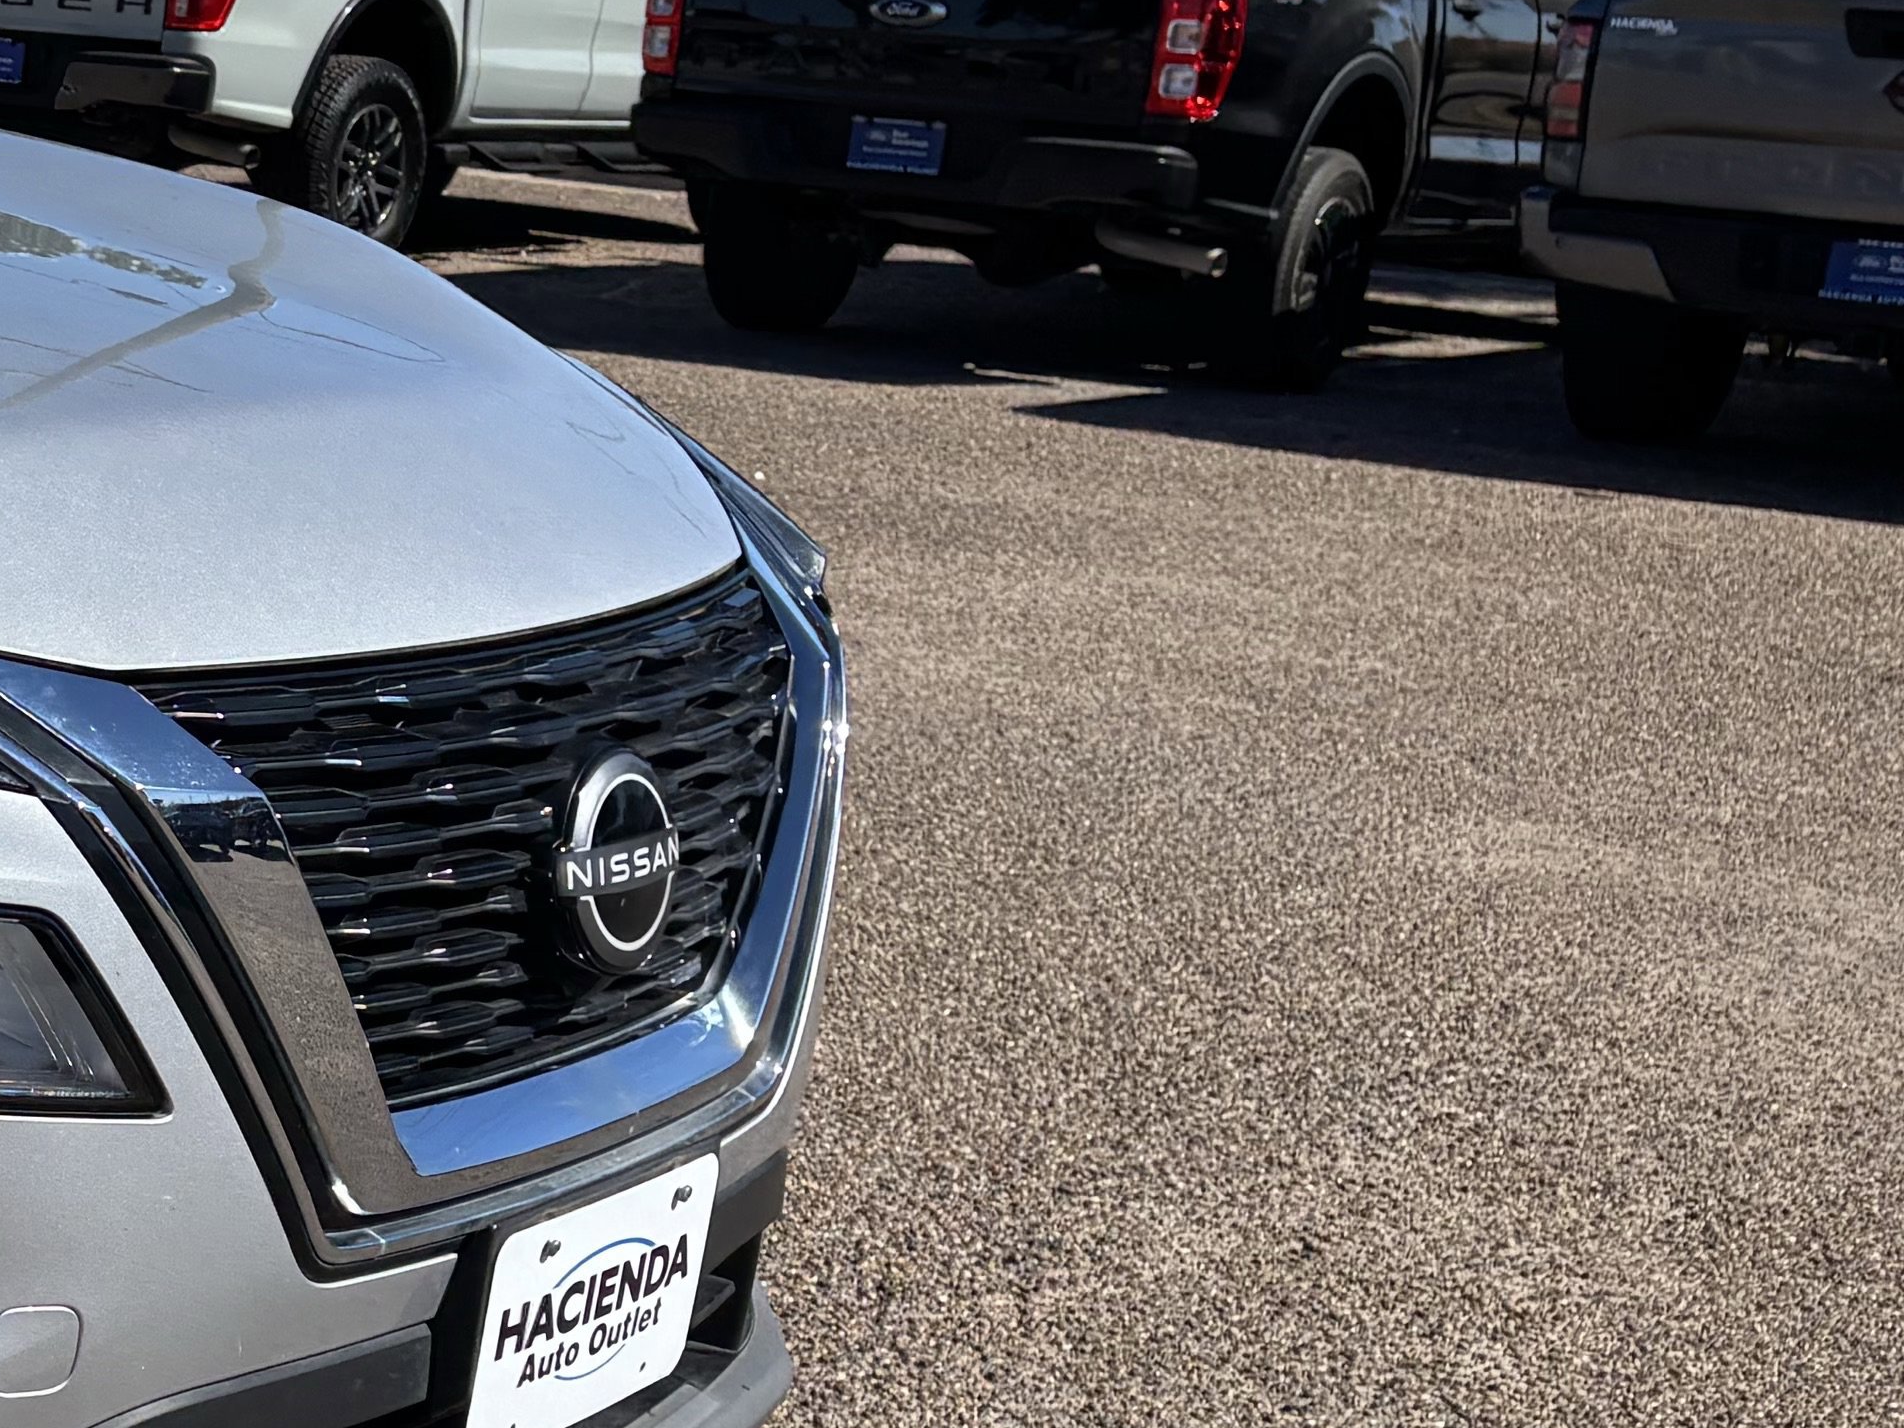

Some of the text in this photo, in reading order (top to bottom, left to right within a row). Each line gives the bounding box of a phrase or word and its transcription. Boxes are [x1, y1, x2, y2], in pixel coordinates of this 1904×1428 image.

[566, 836, 680, 890] NISSAN
[494, 1233, 688, 1362] HACIENDA
[516, 1296, 662, 1388] Auto Outlet
